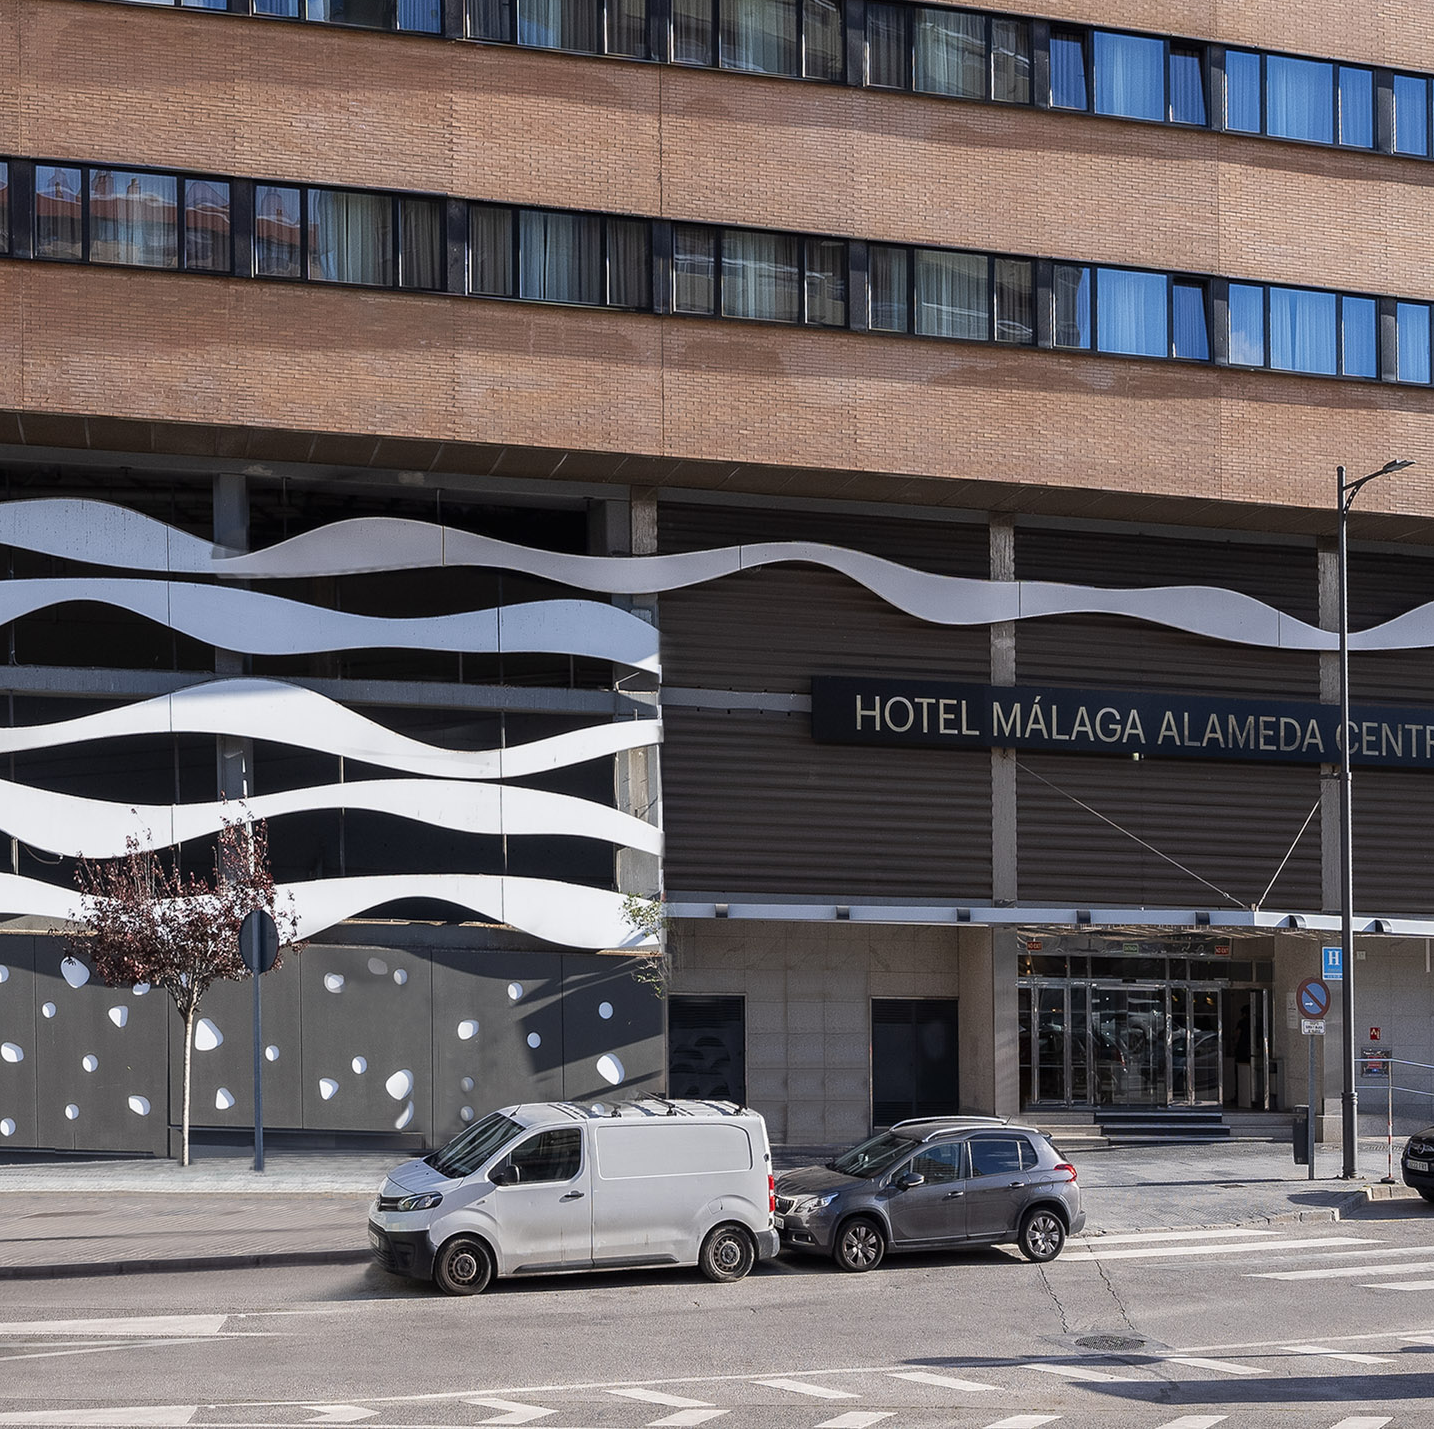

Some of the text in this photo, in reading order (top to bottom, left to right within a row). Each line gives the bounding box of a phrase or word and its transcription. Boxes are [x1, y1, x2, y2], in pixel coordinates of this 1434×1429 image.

[856, 695, 980, 735] HOTEL
[992, 695, 1146, 745] MÁLAGA
[1157, 711, 1325, 754] ALAMEDA
[1328, 950, 1340, 966] H
